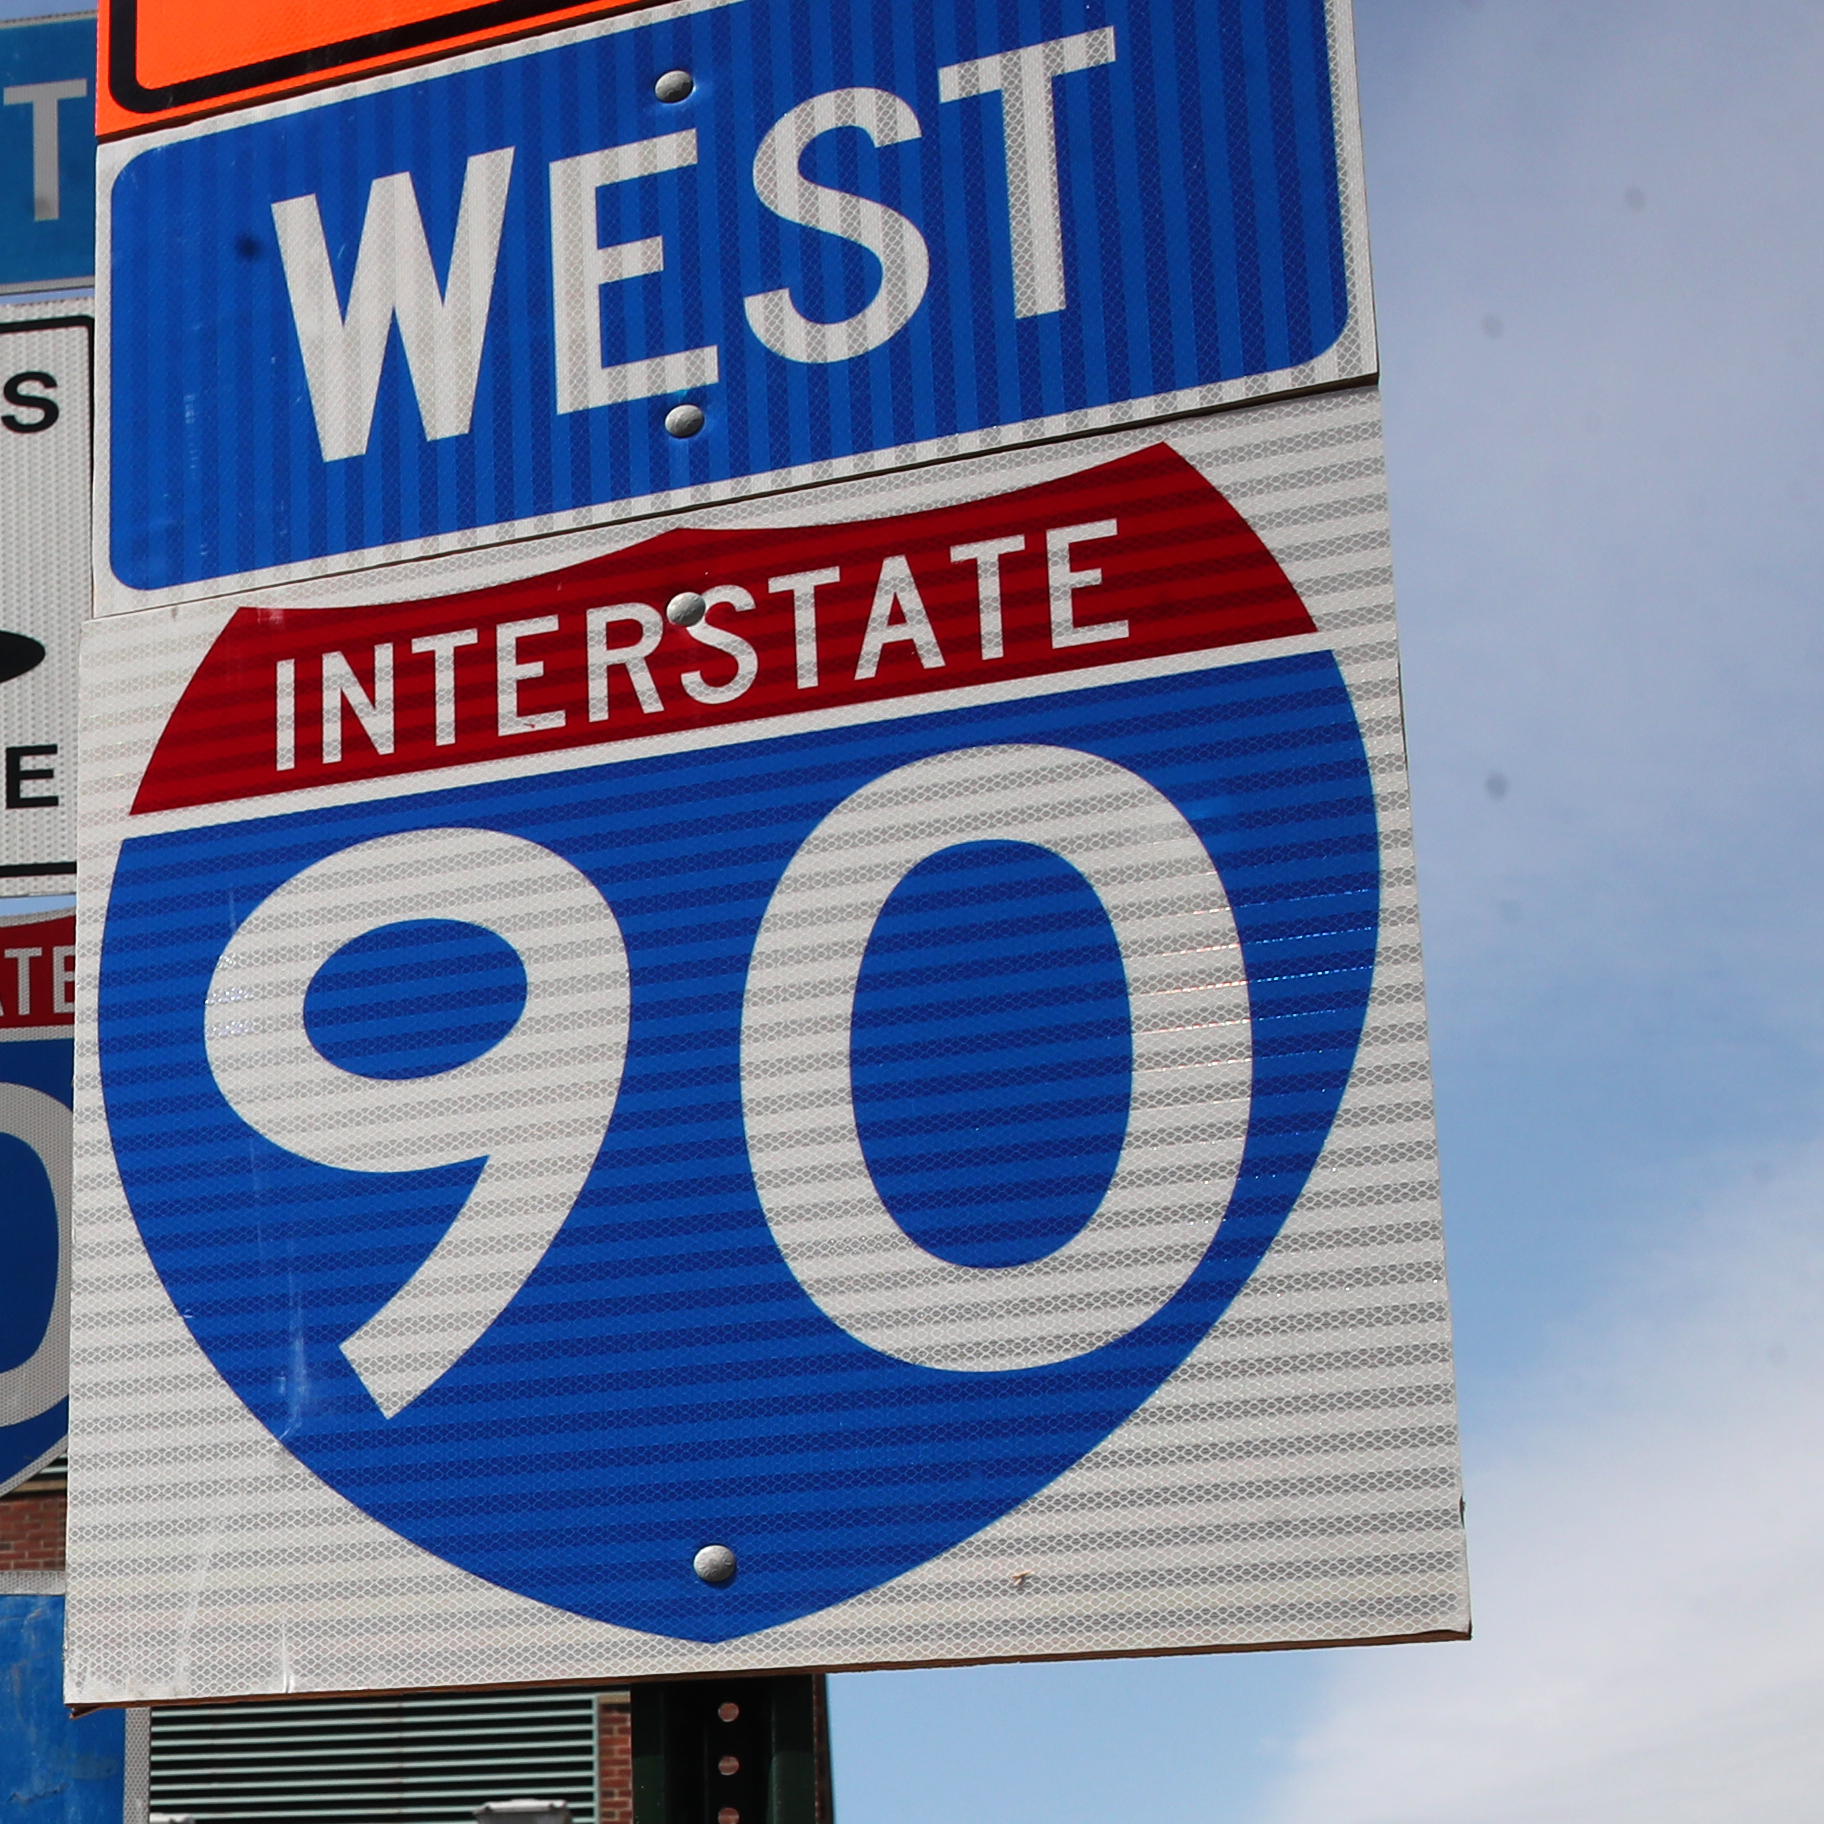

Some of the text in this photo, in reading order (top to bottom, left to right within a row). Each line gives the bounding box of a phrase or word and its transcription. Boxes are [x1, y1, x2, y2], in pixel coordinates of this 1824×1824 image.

[271, 25, 1117, 464] WEST
[274, 517, 1130, 772] INTERSTATE
[205, 741, 1253, 1418] 90
